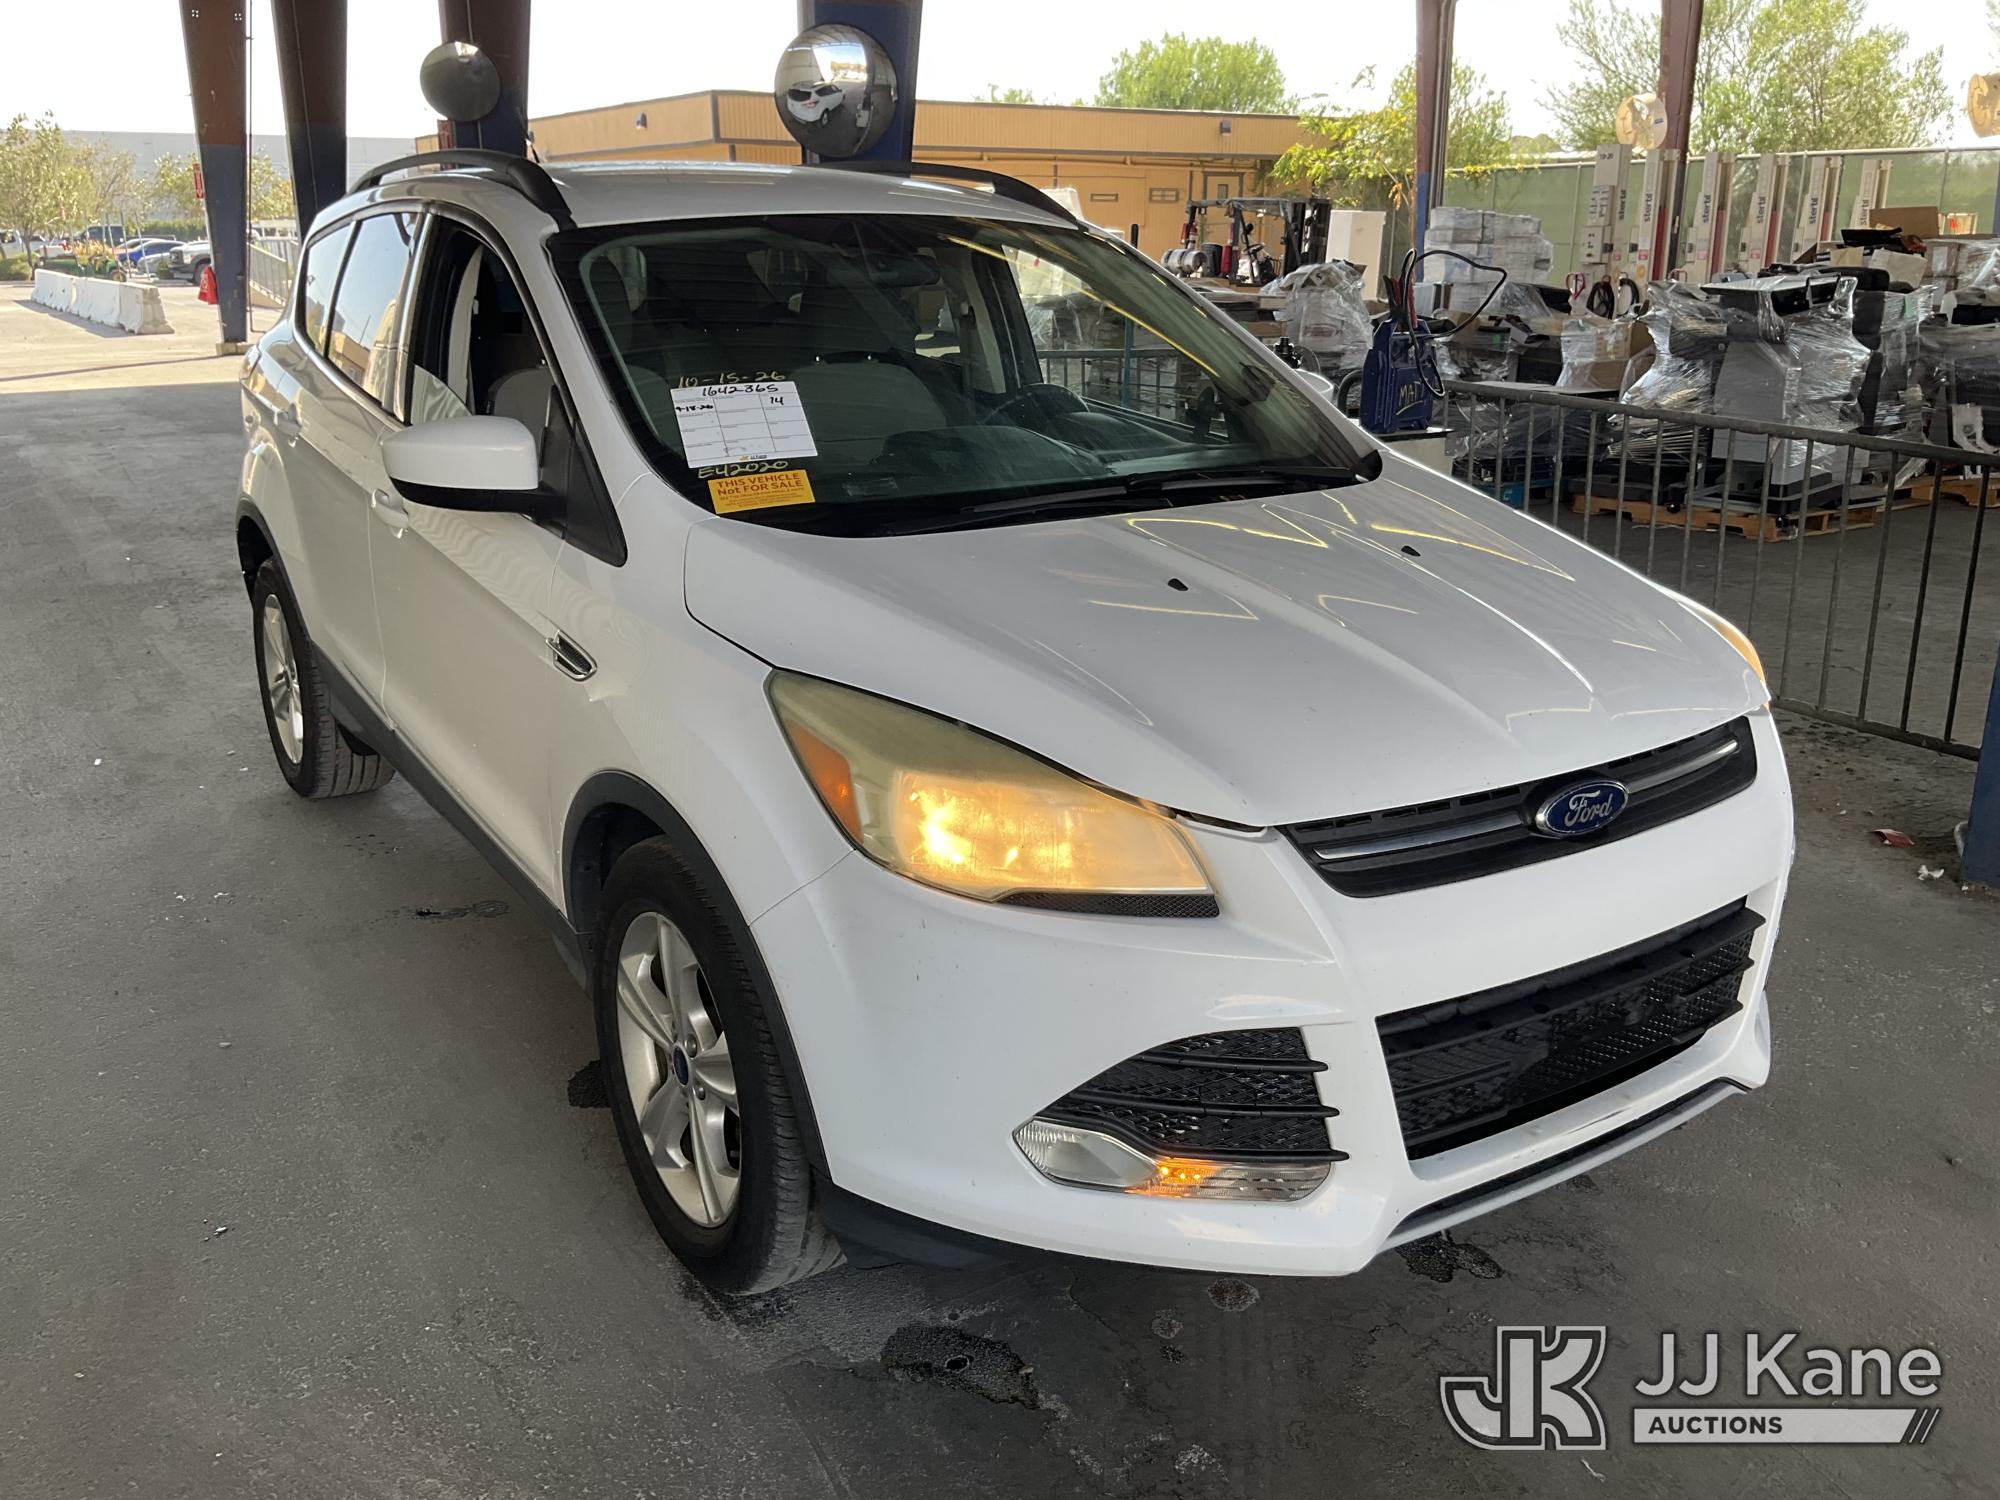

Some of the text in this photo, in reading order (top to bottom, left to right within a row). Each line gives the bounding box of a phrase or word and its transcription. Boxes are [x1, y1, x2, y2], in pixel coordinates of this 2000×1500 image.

[1644, 193, 1653, 223] stertil
[698, 460, 788, 479] E42020
[716, 472, 801, 489] THIS VEHICLE
[717, 486, 742, 496] Not
[743, 484, 769, 493] FOR
[772, 479, 804, 489] SALE
[1564, 790, 1614, 827] Ford
